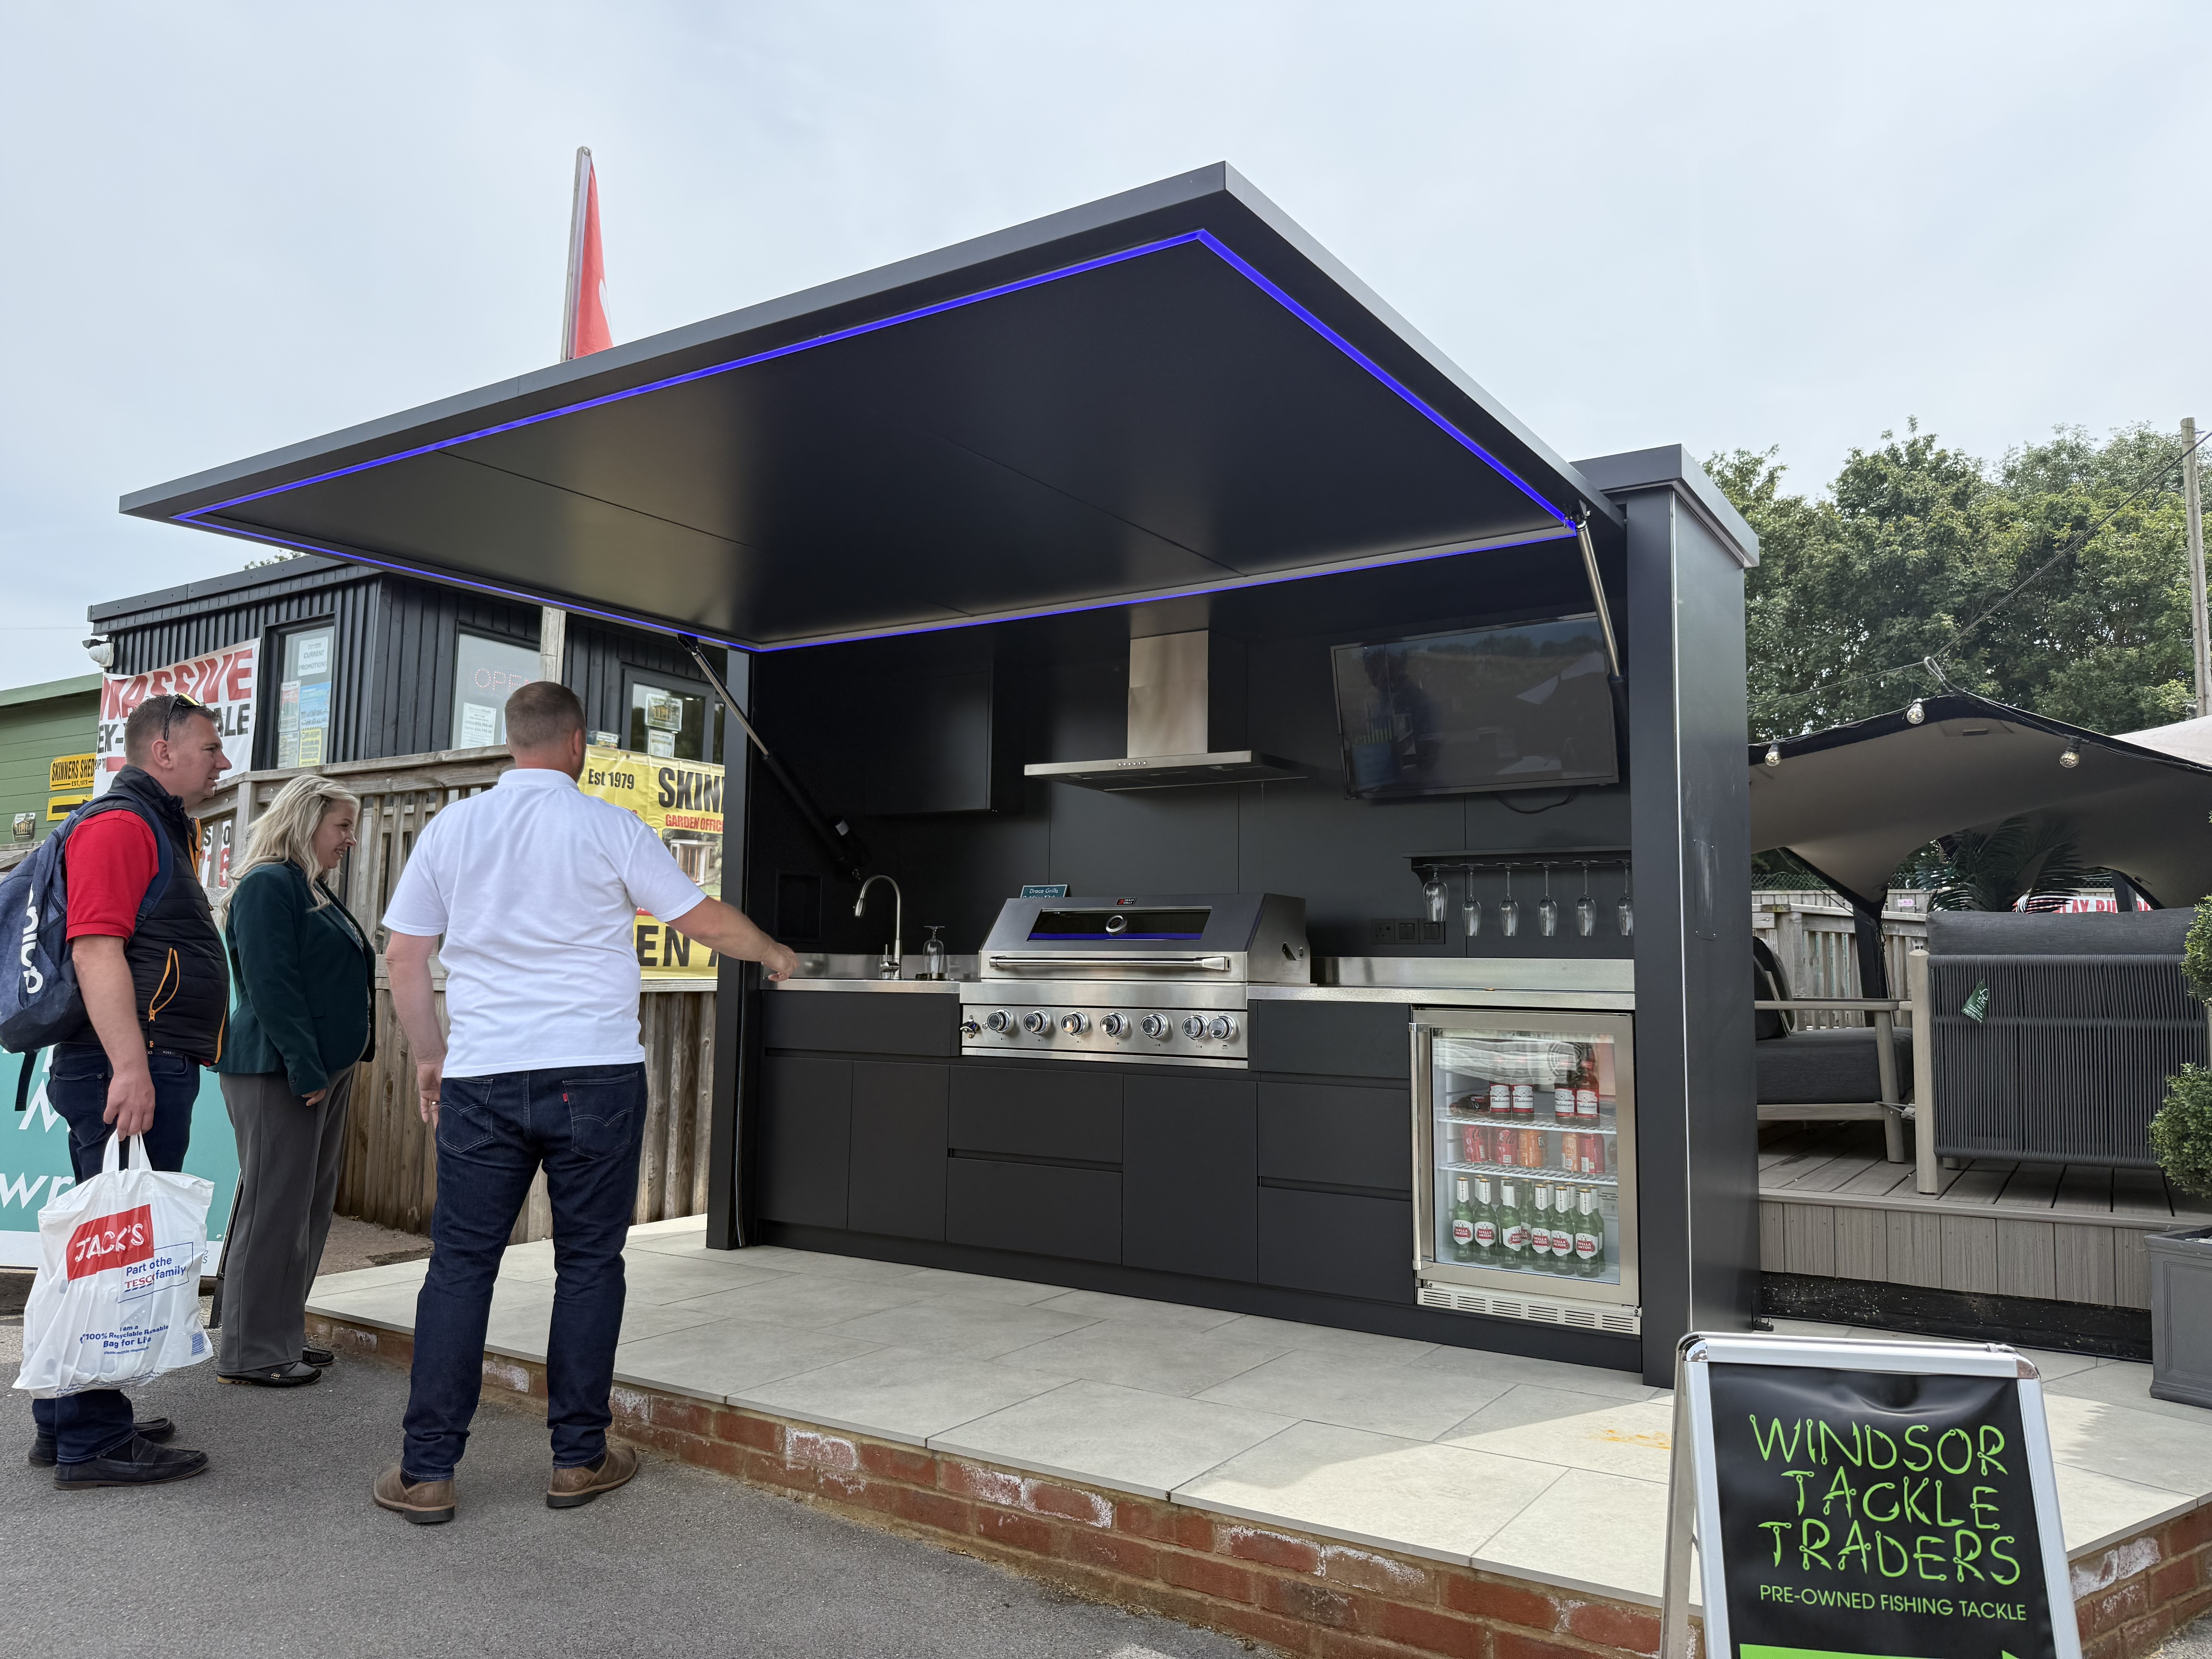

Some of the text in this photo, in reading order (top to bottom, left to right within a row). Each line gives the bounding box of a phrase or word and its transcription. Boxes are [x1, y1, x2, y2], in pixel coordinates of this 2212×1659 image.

[299, 661, 327, 671] PROMOTIONS
[304, 650, 324, 658] CURRENT
[100, 648, 252, 720] MASSIVE
[97, 723, 126, 754] EX-
[52, 759, 79, 781] SKINNERS
[588, 769, 635, 790] Est 1979
[659, 767, 724, 813] SKIN
[666, 814, 699, 829] GARDEN
[75, 1223, 144, 1262] JACK'S
[126, 1263, 147, 1276] Part
[156, 1257, 172, 1267] the
[156, 1265, 187, 1279] family
[137, 1336, 151, 1345] Lie
[1749, 1414, 2008, 1476] WINDSOR
[1781, 1466, 2001, 1529] TACKLE
[1758, 1518, 2021, 1585] TRADERS
[1760, 1585, 2027, 1621] PRE-OWNED FISHING TACKLE
